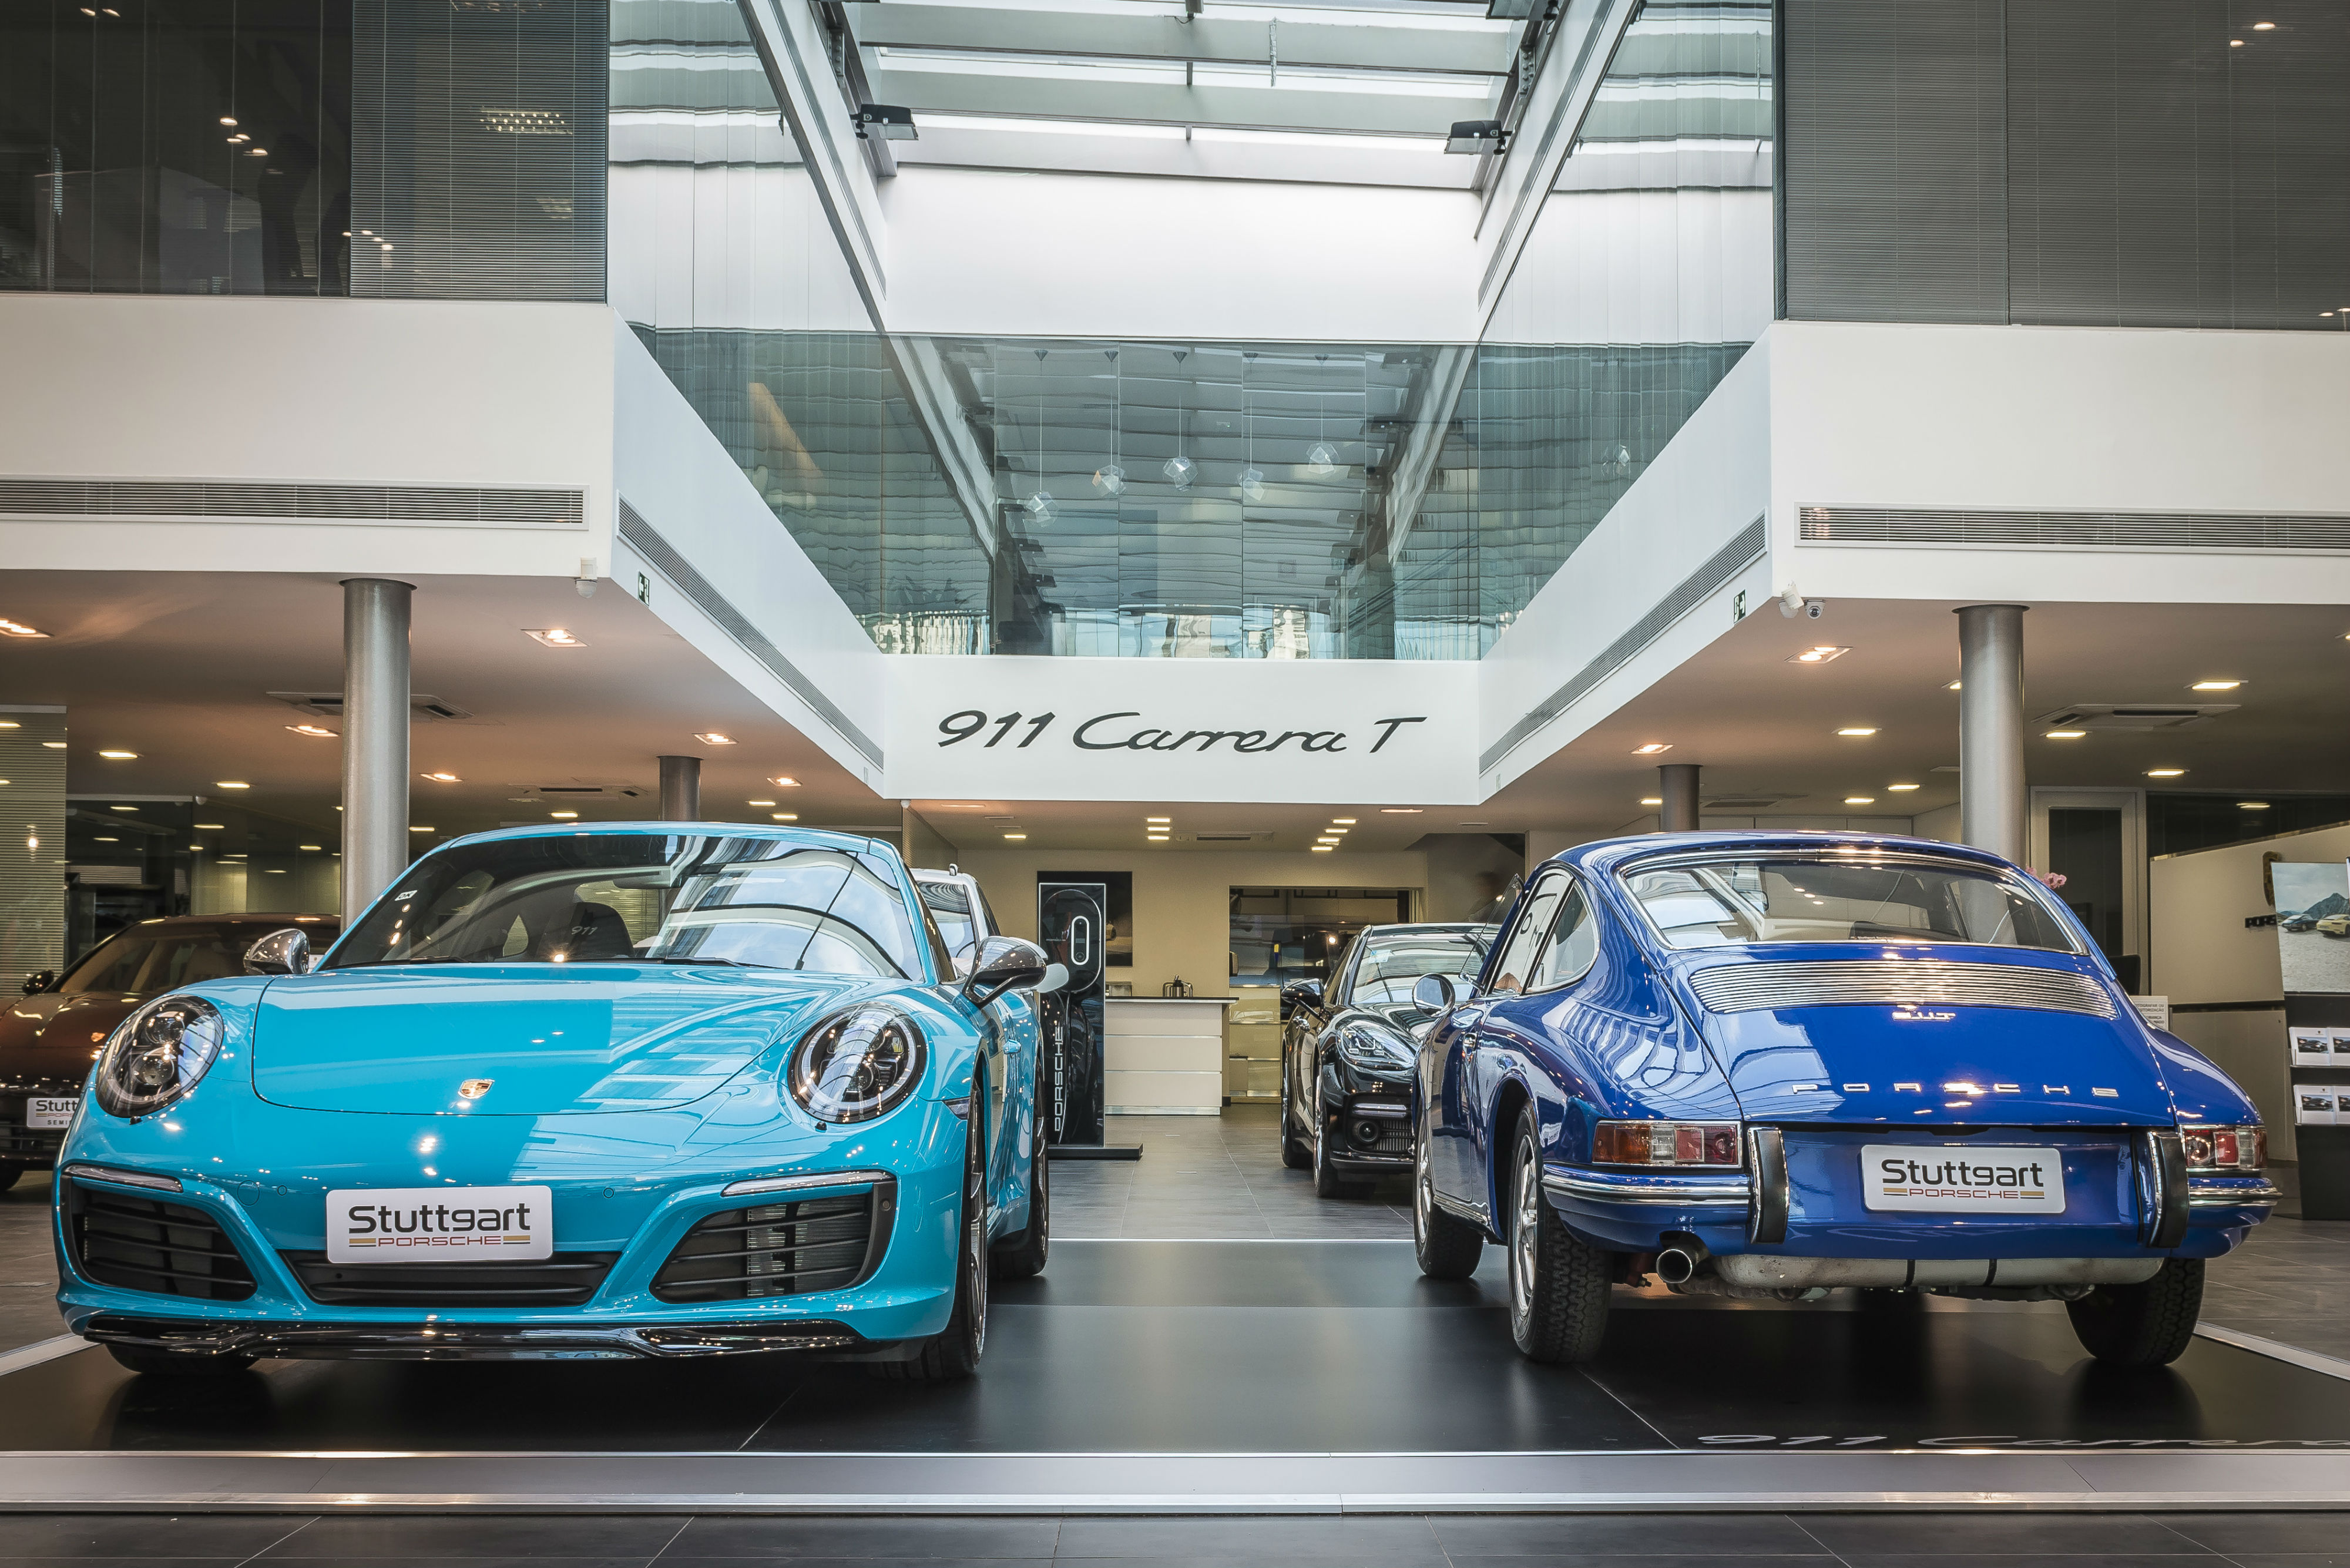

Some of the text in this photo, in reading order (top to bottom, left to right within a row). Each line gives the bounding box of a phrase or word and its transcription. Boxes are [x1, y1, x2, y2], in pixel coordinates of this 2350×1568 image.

[937, 710, 1428, 753] 911 Carrera T
[2245, 914, 2277, 928] PORS
[571, 926, 598, 935] 911
[1055, 1026, 1063, 1131] PORSCHE
[36, 1100, 78, 1112] Stutt
[1881, 1159, 2044, 1187] Stuttgart
[1909, 1188, 2019, 1199] PORSCHE
[348, 1203, 531, 1234] Stuttgart
[378, 1235, 502, 1247] PORSCHE
[1697, 1434, 1888, 1446] 911
